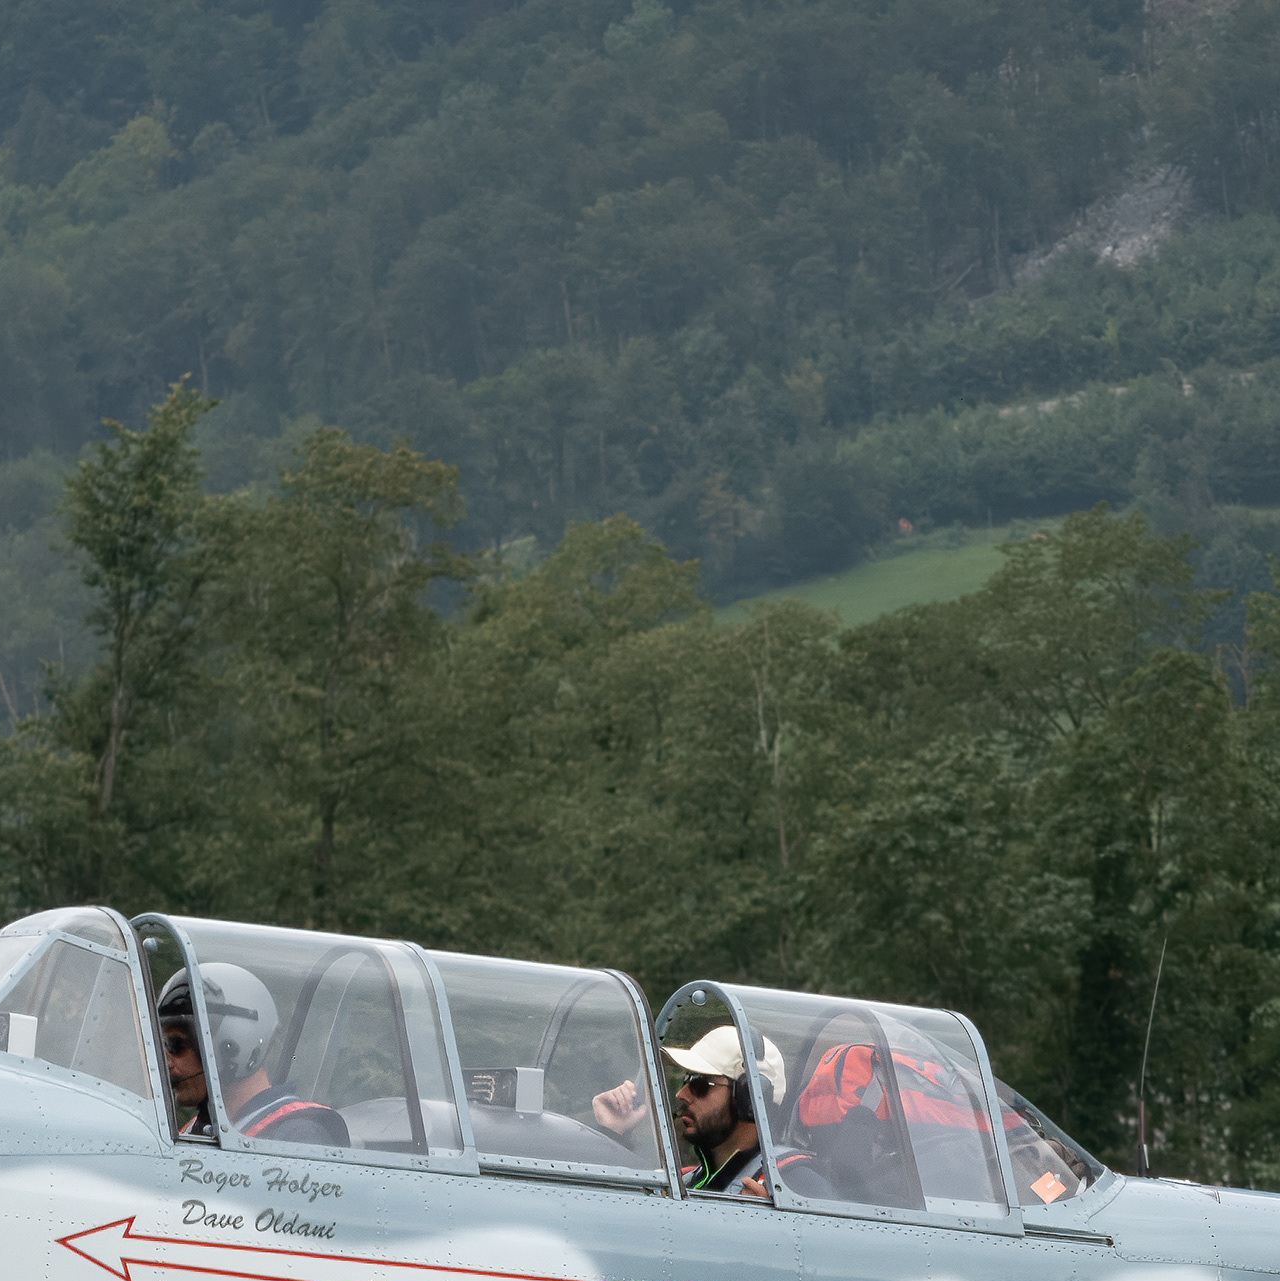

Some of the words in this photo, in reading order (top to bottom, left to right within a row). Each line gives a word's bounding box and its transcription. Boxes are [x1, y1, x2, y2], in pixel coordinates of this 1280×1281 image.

[179, 1159, 251, 1193] Roger
[262, 1167, 343, 1202] Holzer
[182, 1199, 244, 1230] Dave
[255, 1208, 336, 1239] Oldani
